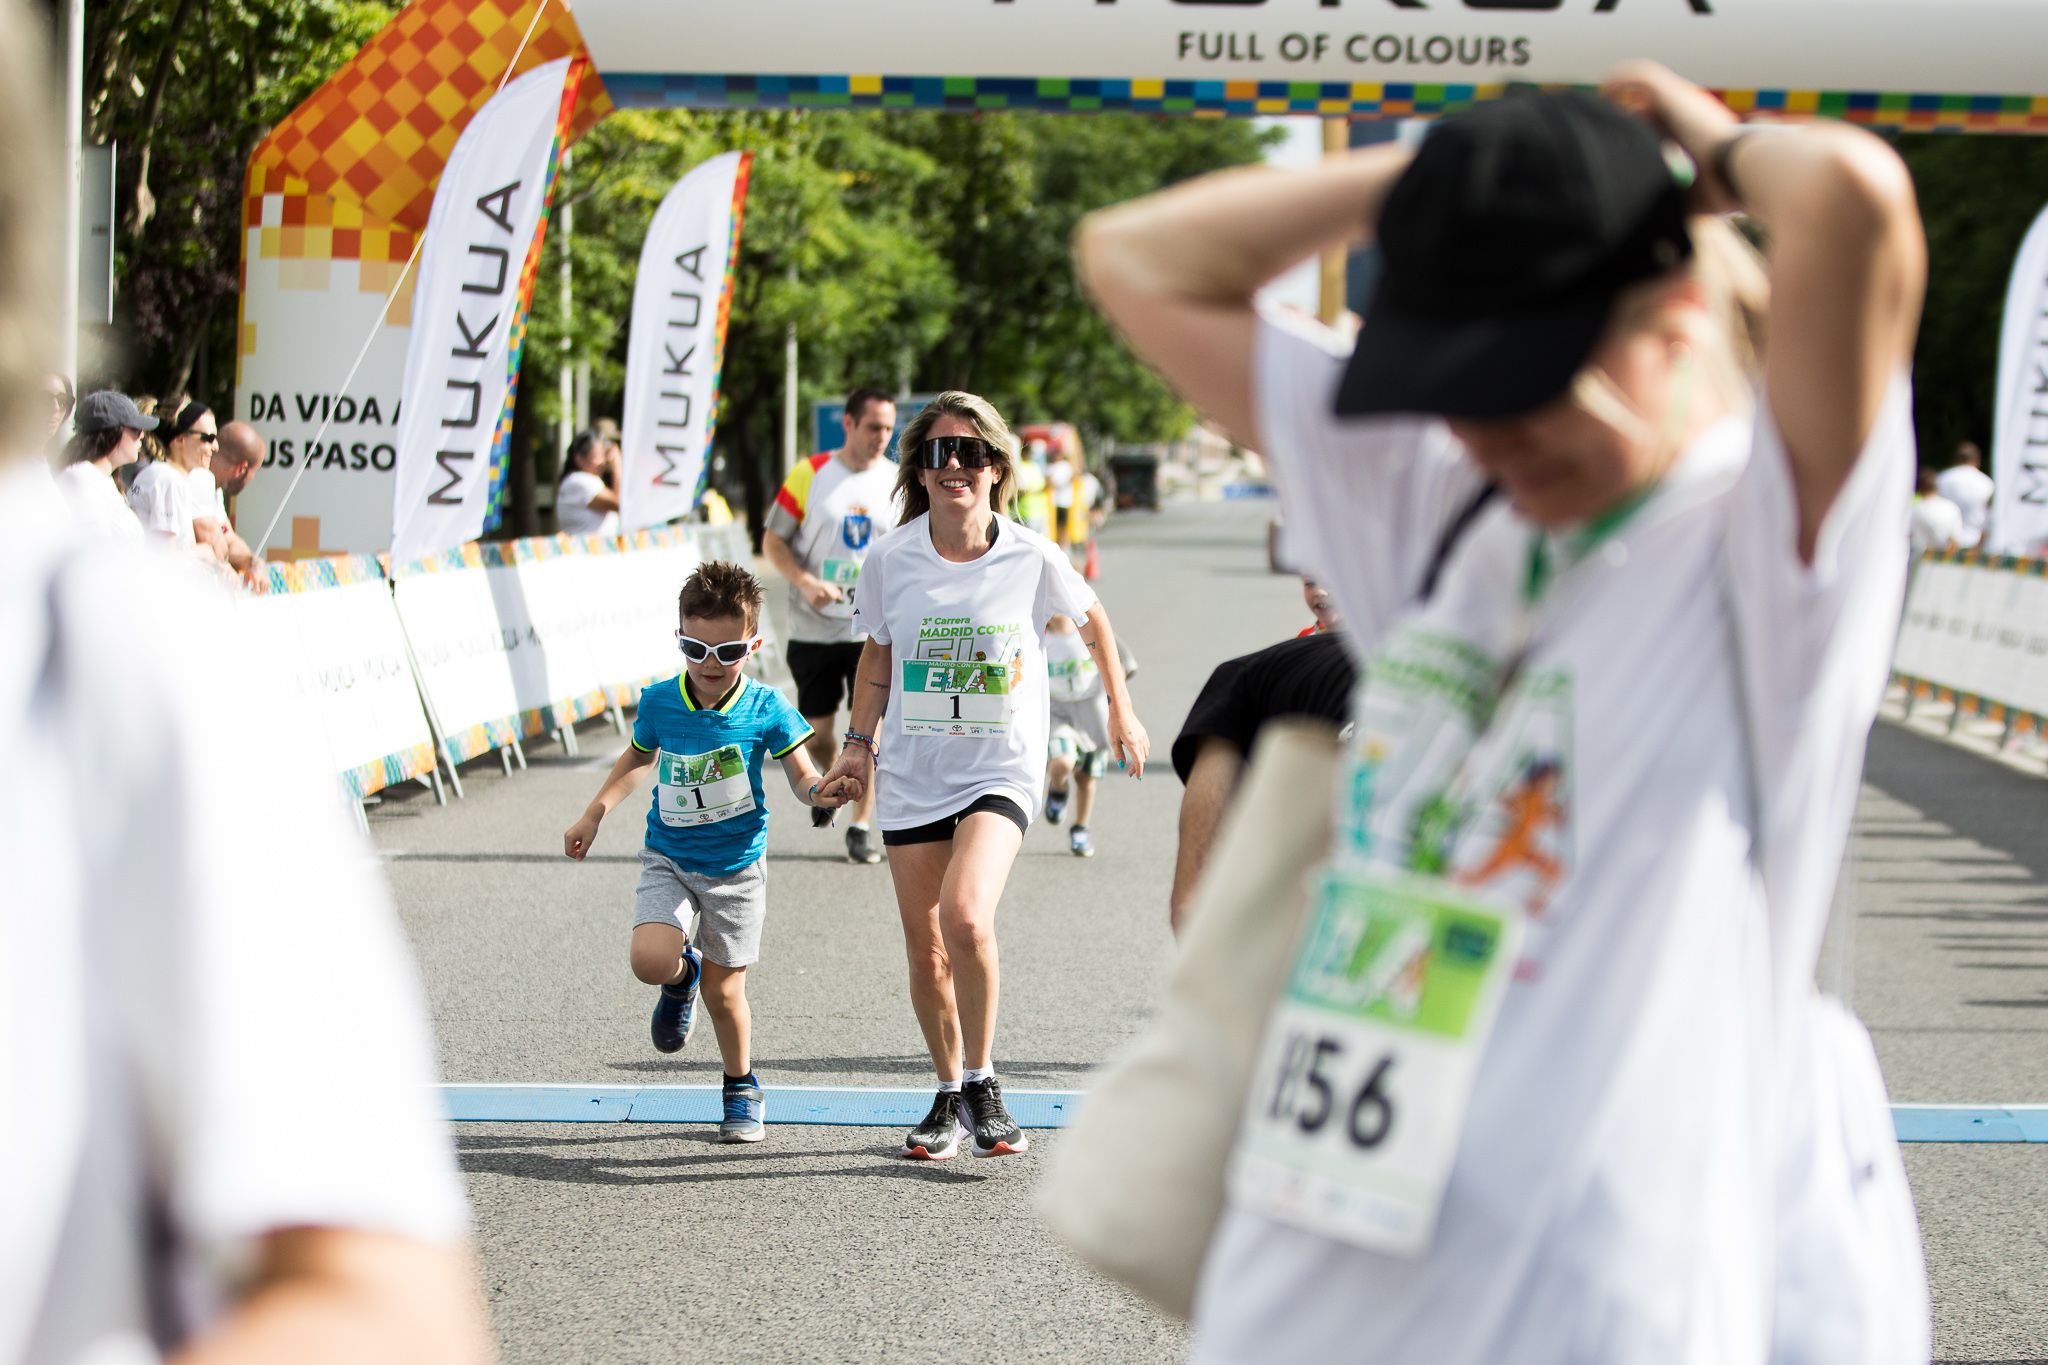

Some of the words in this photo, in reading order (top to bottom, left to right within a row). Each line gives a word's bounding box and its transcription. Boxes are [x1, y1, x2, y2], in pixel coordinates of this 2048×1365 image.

[1178, 32, 1265, 60] FULL
[1279, 33, 1331, 62] OF
[1344, 34, 1532, 66] COLOURS
[427, 180, 522, 506] MUKUA
[652, 244, 709, 487] MUKUA
[251, 393, 286, 422] DA
[296, 394, 383, 425] VIDA
[920, 627, 973, 638] MADRID
[977, 625, 1005, 635] CON
[935, 616, 970, 625] Carrera
[924, 667, 986, 693] ELA
[950, 694, 962, 720] 1
[670, 758, 722, 786] ELA
[690, 787, 707, 810] 1
